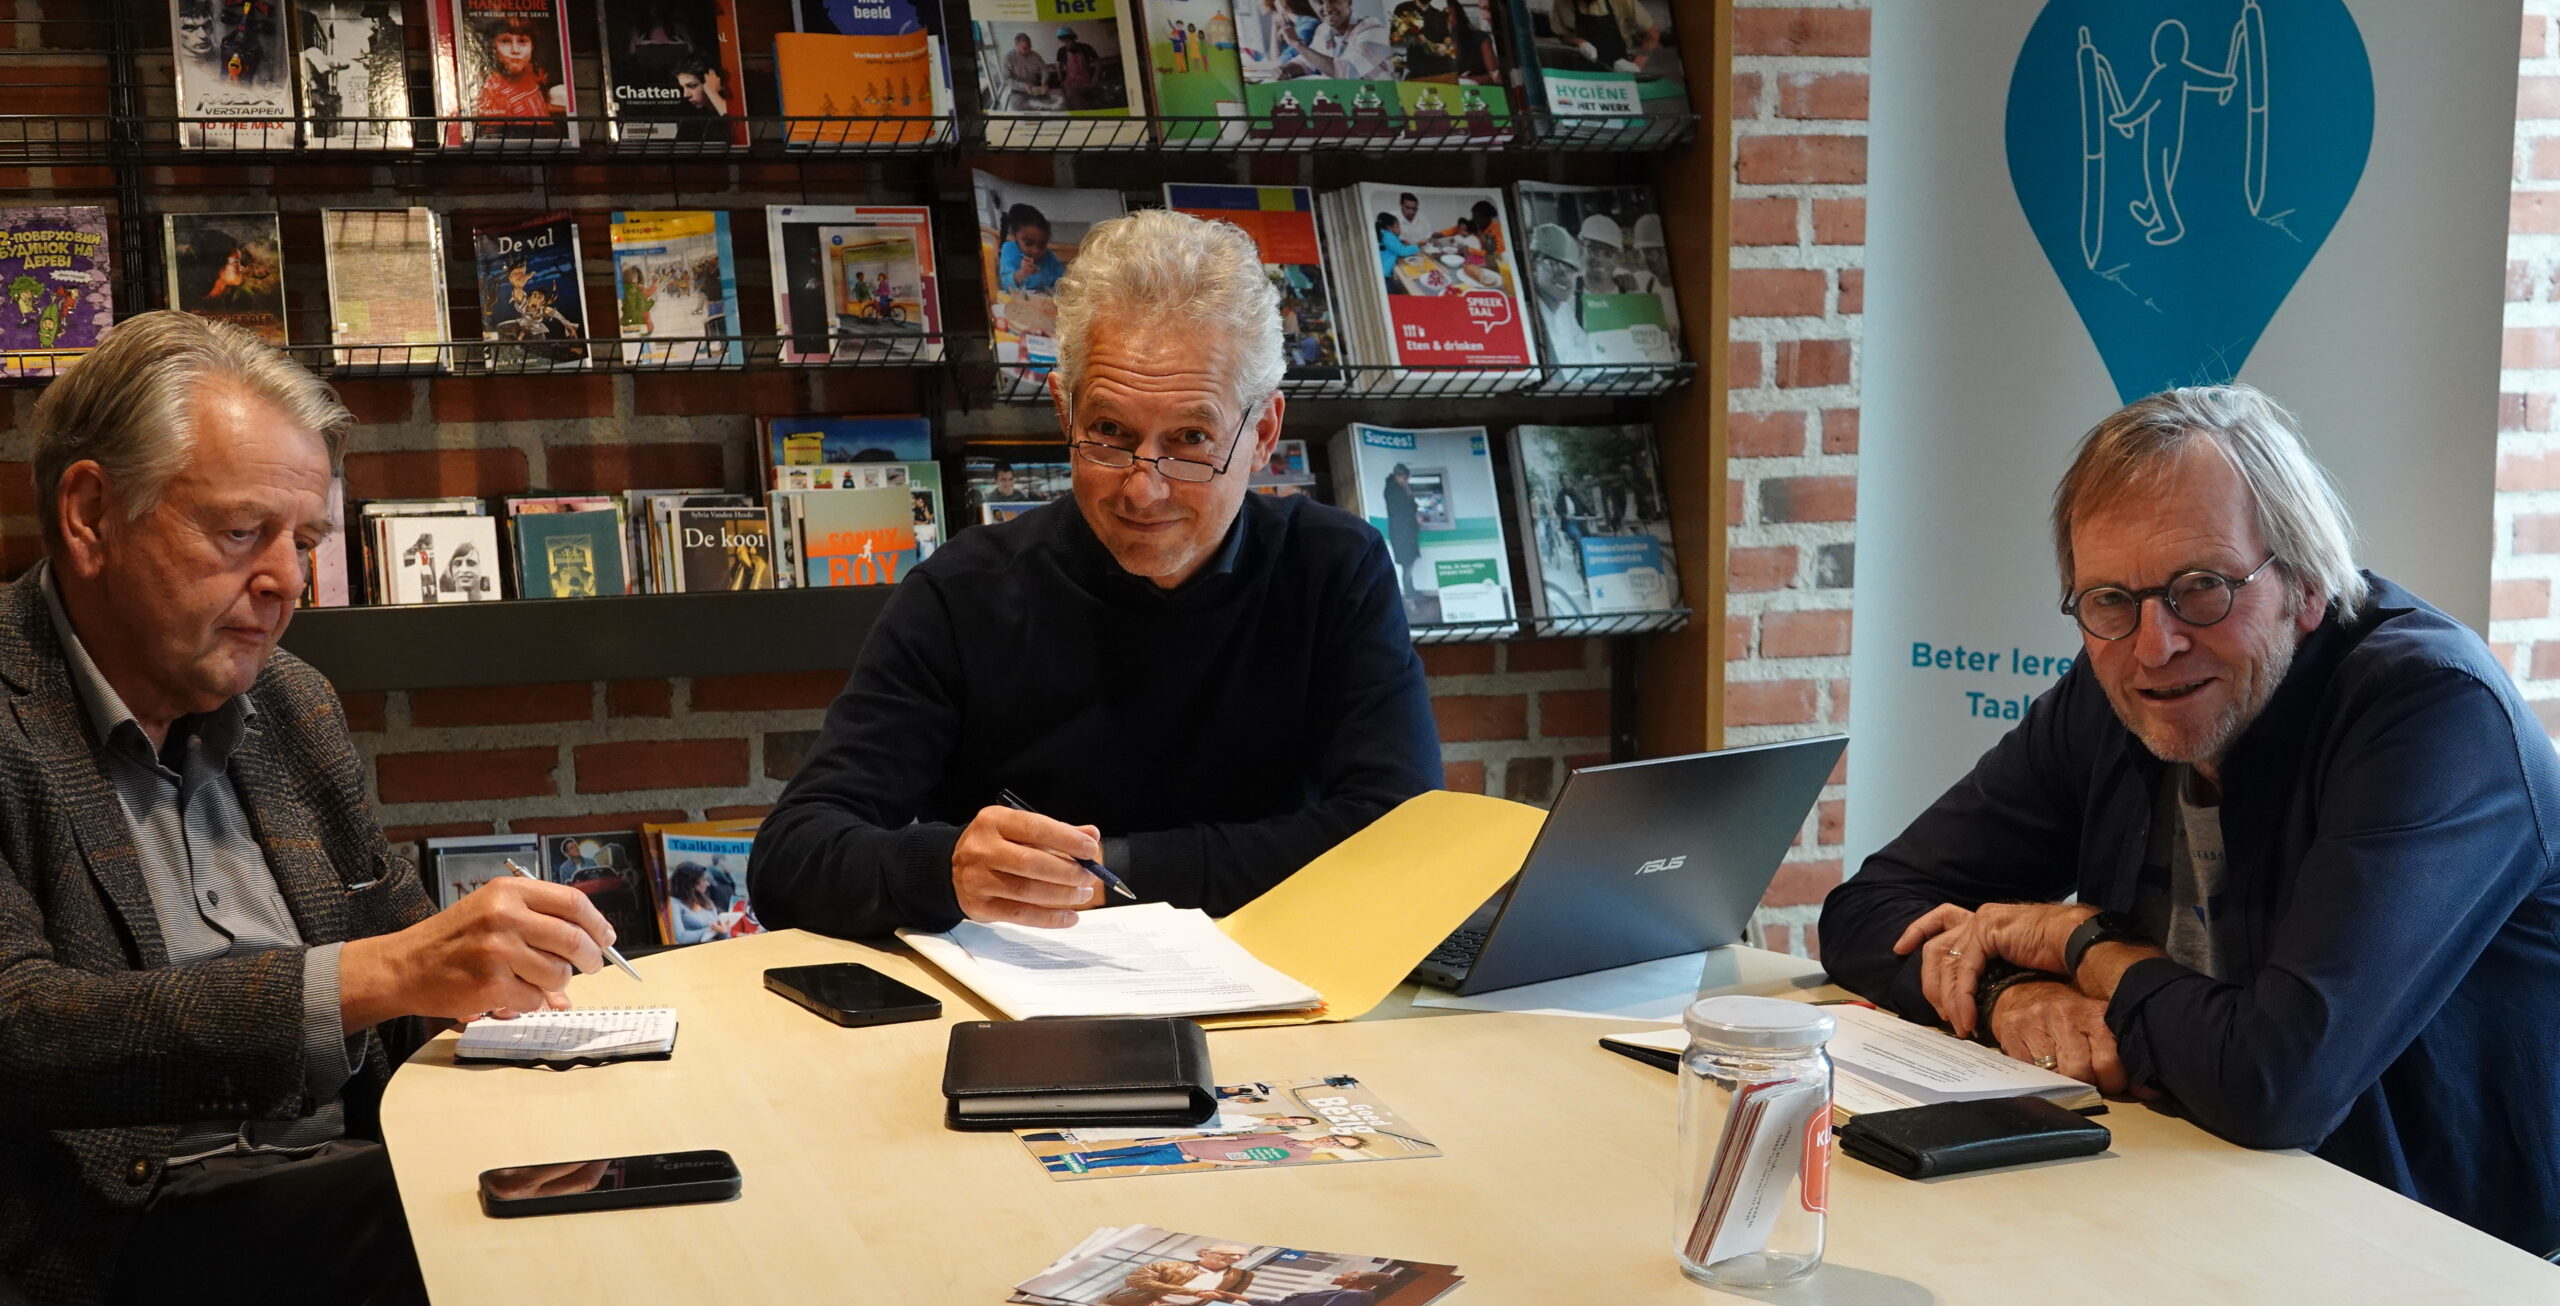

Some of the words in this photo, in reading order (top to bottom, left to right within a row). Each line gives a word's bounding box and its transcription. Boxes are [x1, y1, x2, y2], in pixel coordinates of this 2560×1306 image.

[853, 5, 892, 19] beeld
[615, 85, 681, 99] Chatten
[1556, 84, 1629, 100] HYGIËNE
[204, 107, 284, 116] VERSTAPPEN
[1598, 103, 1631, 112] WERK
[220, 121, 248, 130] THE
[251, 121, 284, 131] MAX
[497, 236, 523, 255] De
[527, 227, 554, 250] val
[74, 242, 94, 257] НА
[23, 255, 72, 270] ДЕРЕВІ
[1466, 297, 1503, 308] SPREEK
[1469, 307, 1494, 317] TAAL
[1406, 341, 1430, 351] Eten
[1433, 341, 1441, 351] &
[1443, 341, 1484, 351] drinken
[1365, 431, 1413, 447] Succes!
[685, 528, 715, 548] De
[720, 527, 765, 548] kooi
[828, 528, 897, 548] SONNY
[828, 552, 899, 586] BOY
[1912, 642, 2000, 672] Beter
[673, 839, 745, 853] Taalklas.nl
[1634, 855, 1687, 876] ASUS
[1307, 1096, 1377, 1136] Bezig
[1350, 1104, 1392, 1126] Goed
